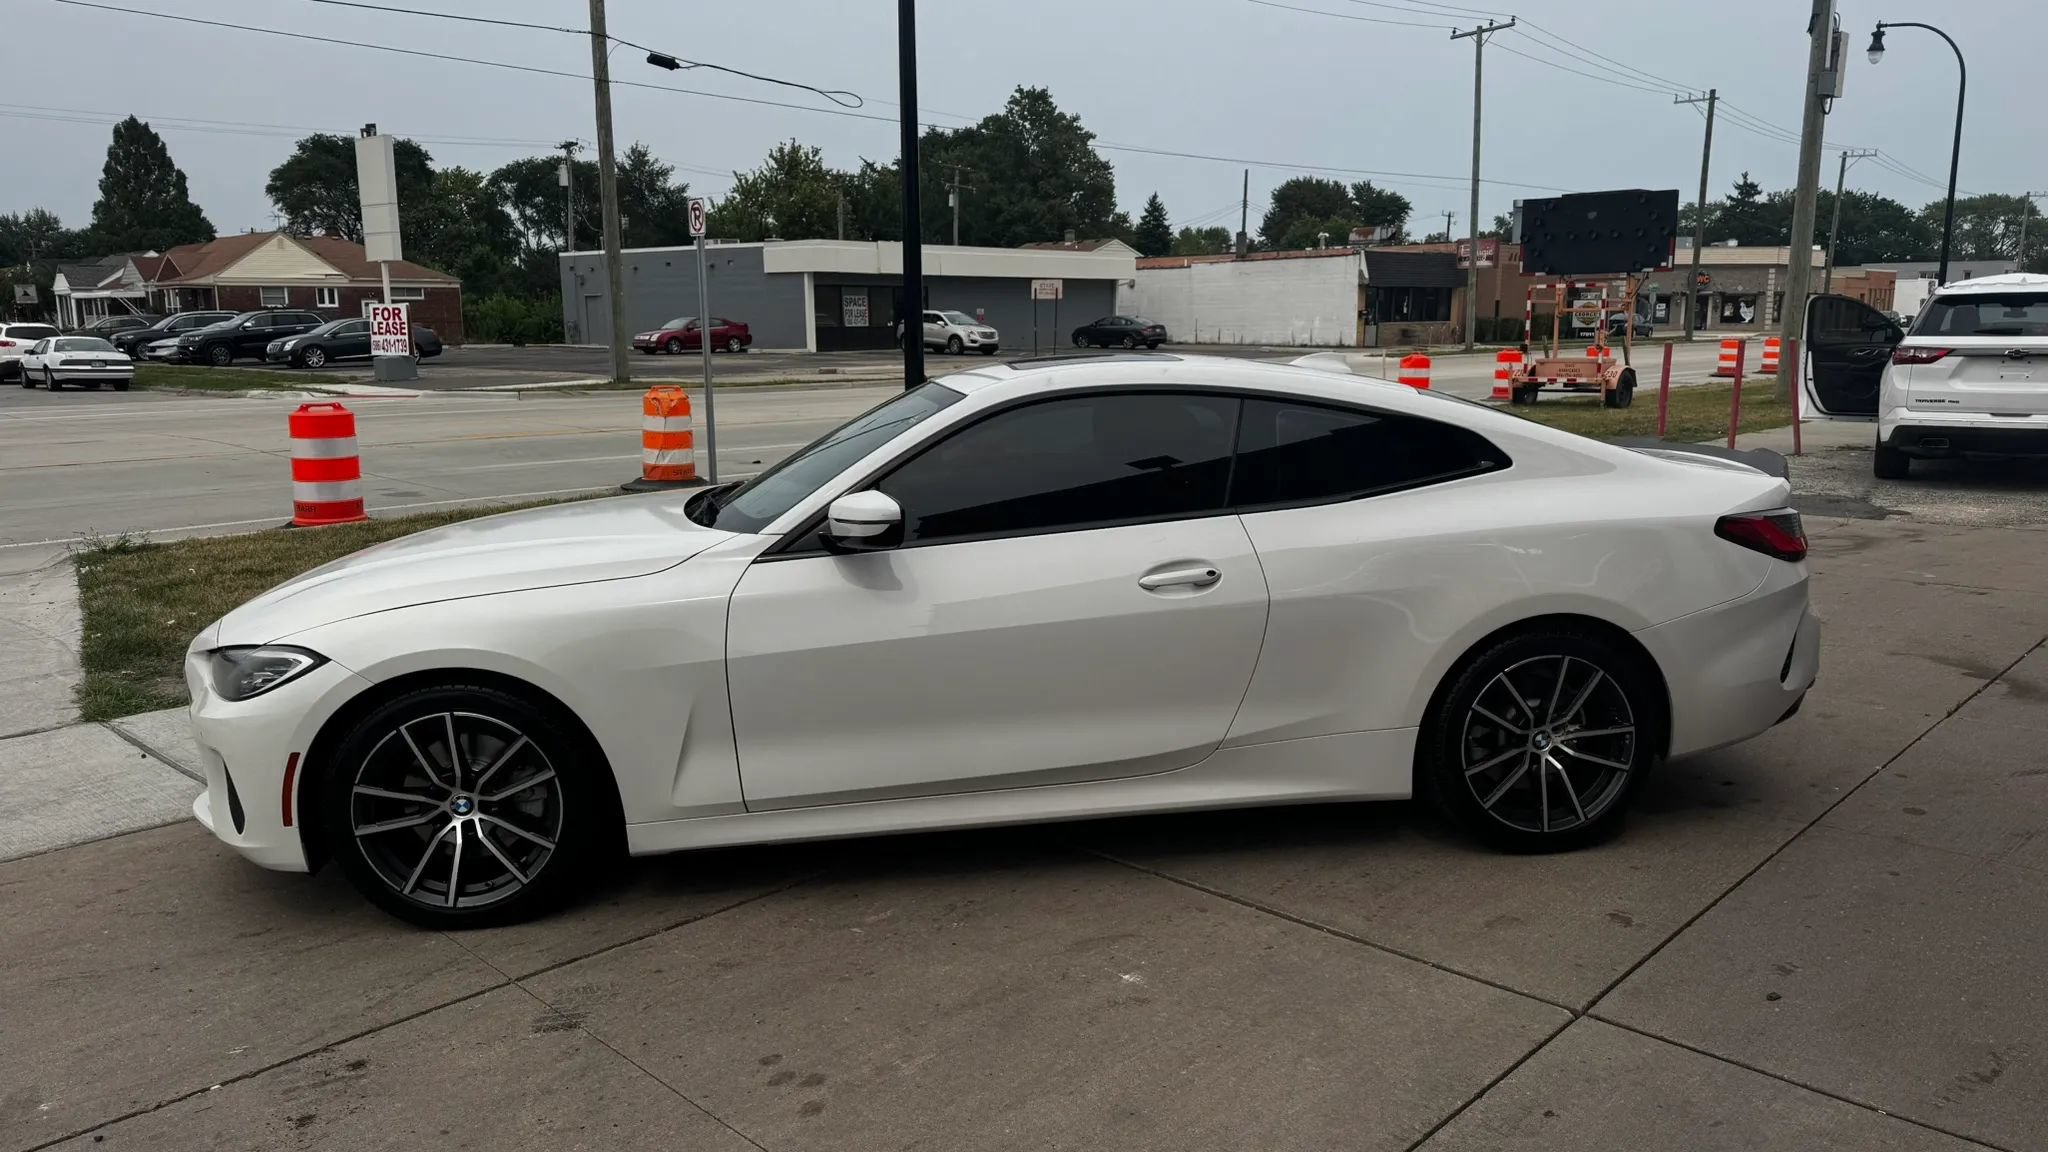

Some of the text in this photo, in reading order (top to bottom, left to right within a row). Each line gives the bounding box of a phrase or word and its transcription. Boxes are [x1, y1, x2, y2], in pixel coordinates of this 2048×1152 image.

[844, 297, 867, 308] SPACE
[372, 307, 402, 321] FOR
[845, 308, 868, 318] FOR LEASE
[371, 322, 407, 335] LEASE
[382, 338, 407, 352] 431-1739
[1605, 370, 1618, 378] 230
